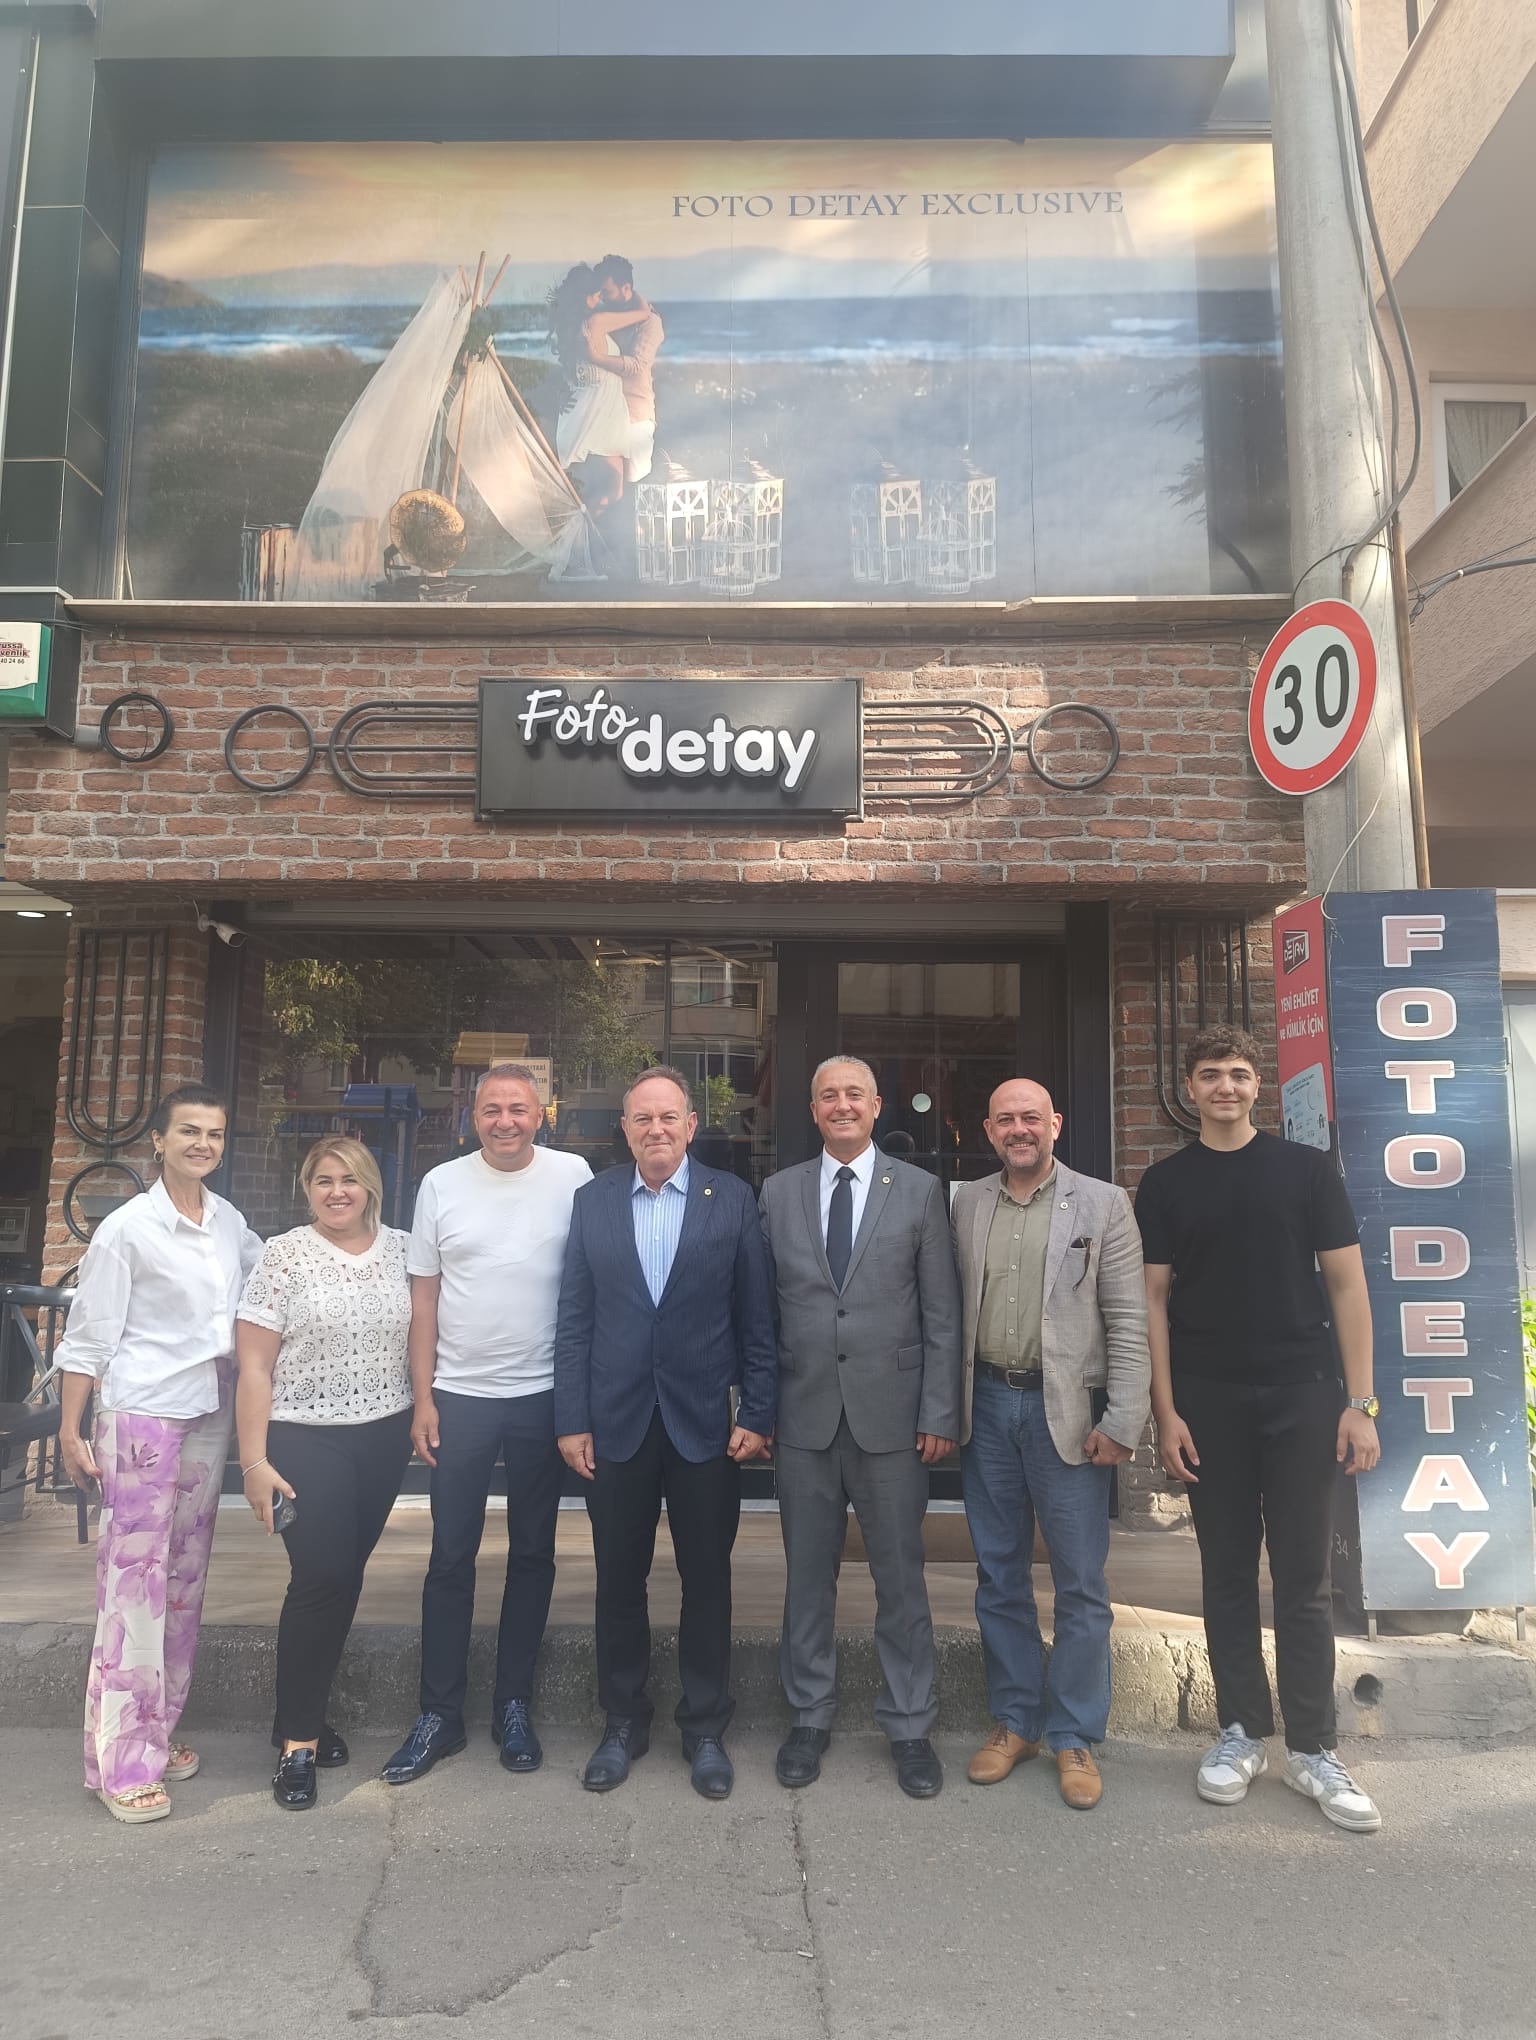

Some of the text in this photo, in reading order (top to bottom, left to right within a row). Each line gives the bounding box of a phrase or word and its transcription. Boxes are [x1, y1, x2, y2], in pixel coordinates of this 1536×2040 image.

[672, 191, 1125, 217] FOTO DETAY EXCLUSIVE
[1272, 643, 1350, 746] 30
[517, 688, 816, 789] Foto detay
[1281, 986, 1320, 1013] YENİ EHLİYET
[1286, 1016, 1306, 1039] KİMLİK
[1307, 1012, 1324, 1038] İÇİN
[1376, 914, 1491, 1590] FOTO DETAY
